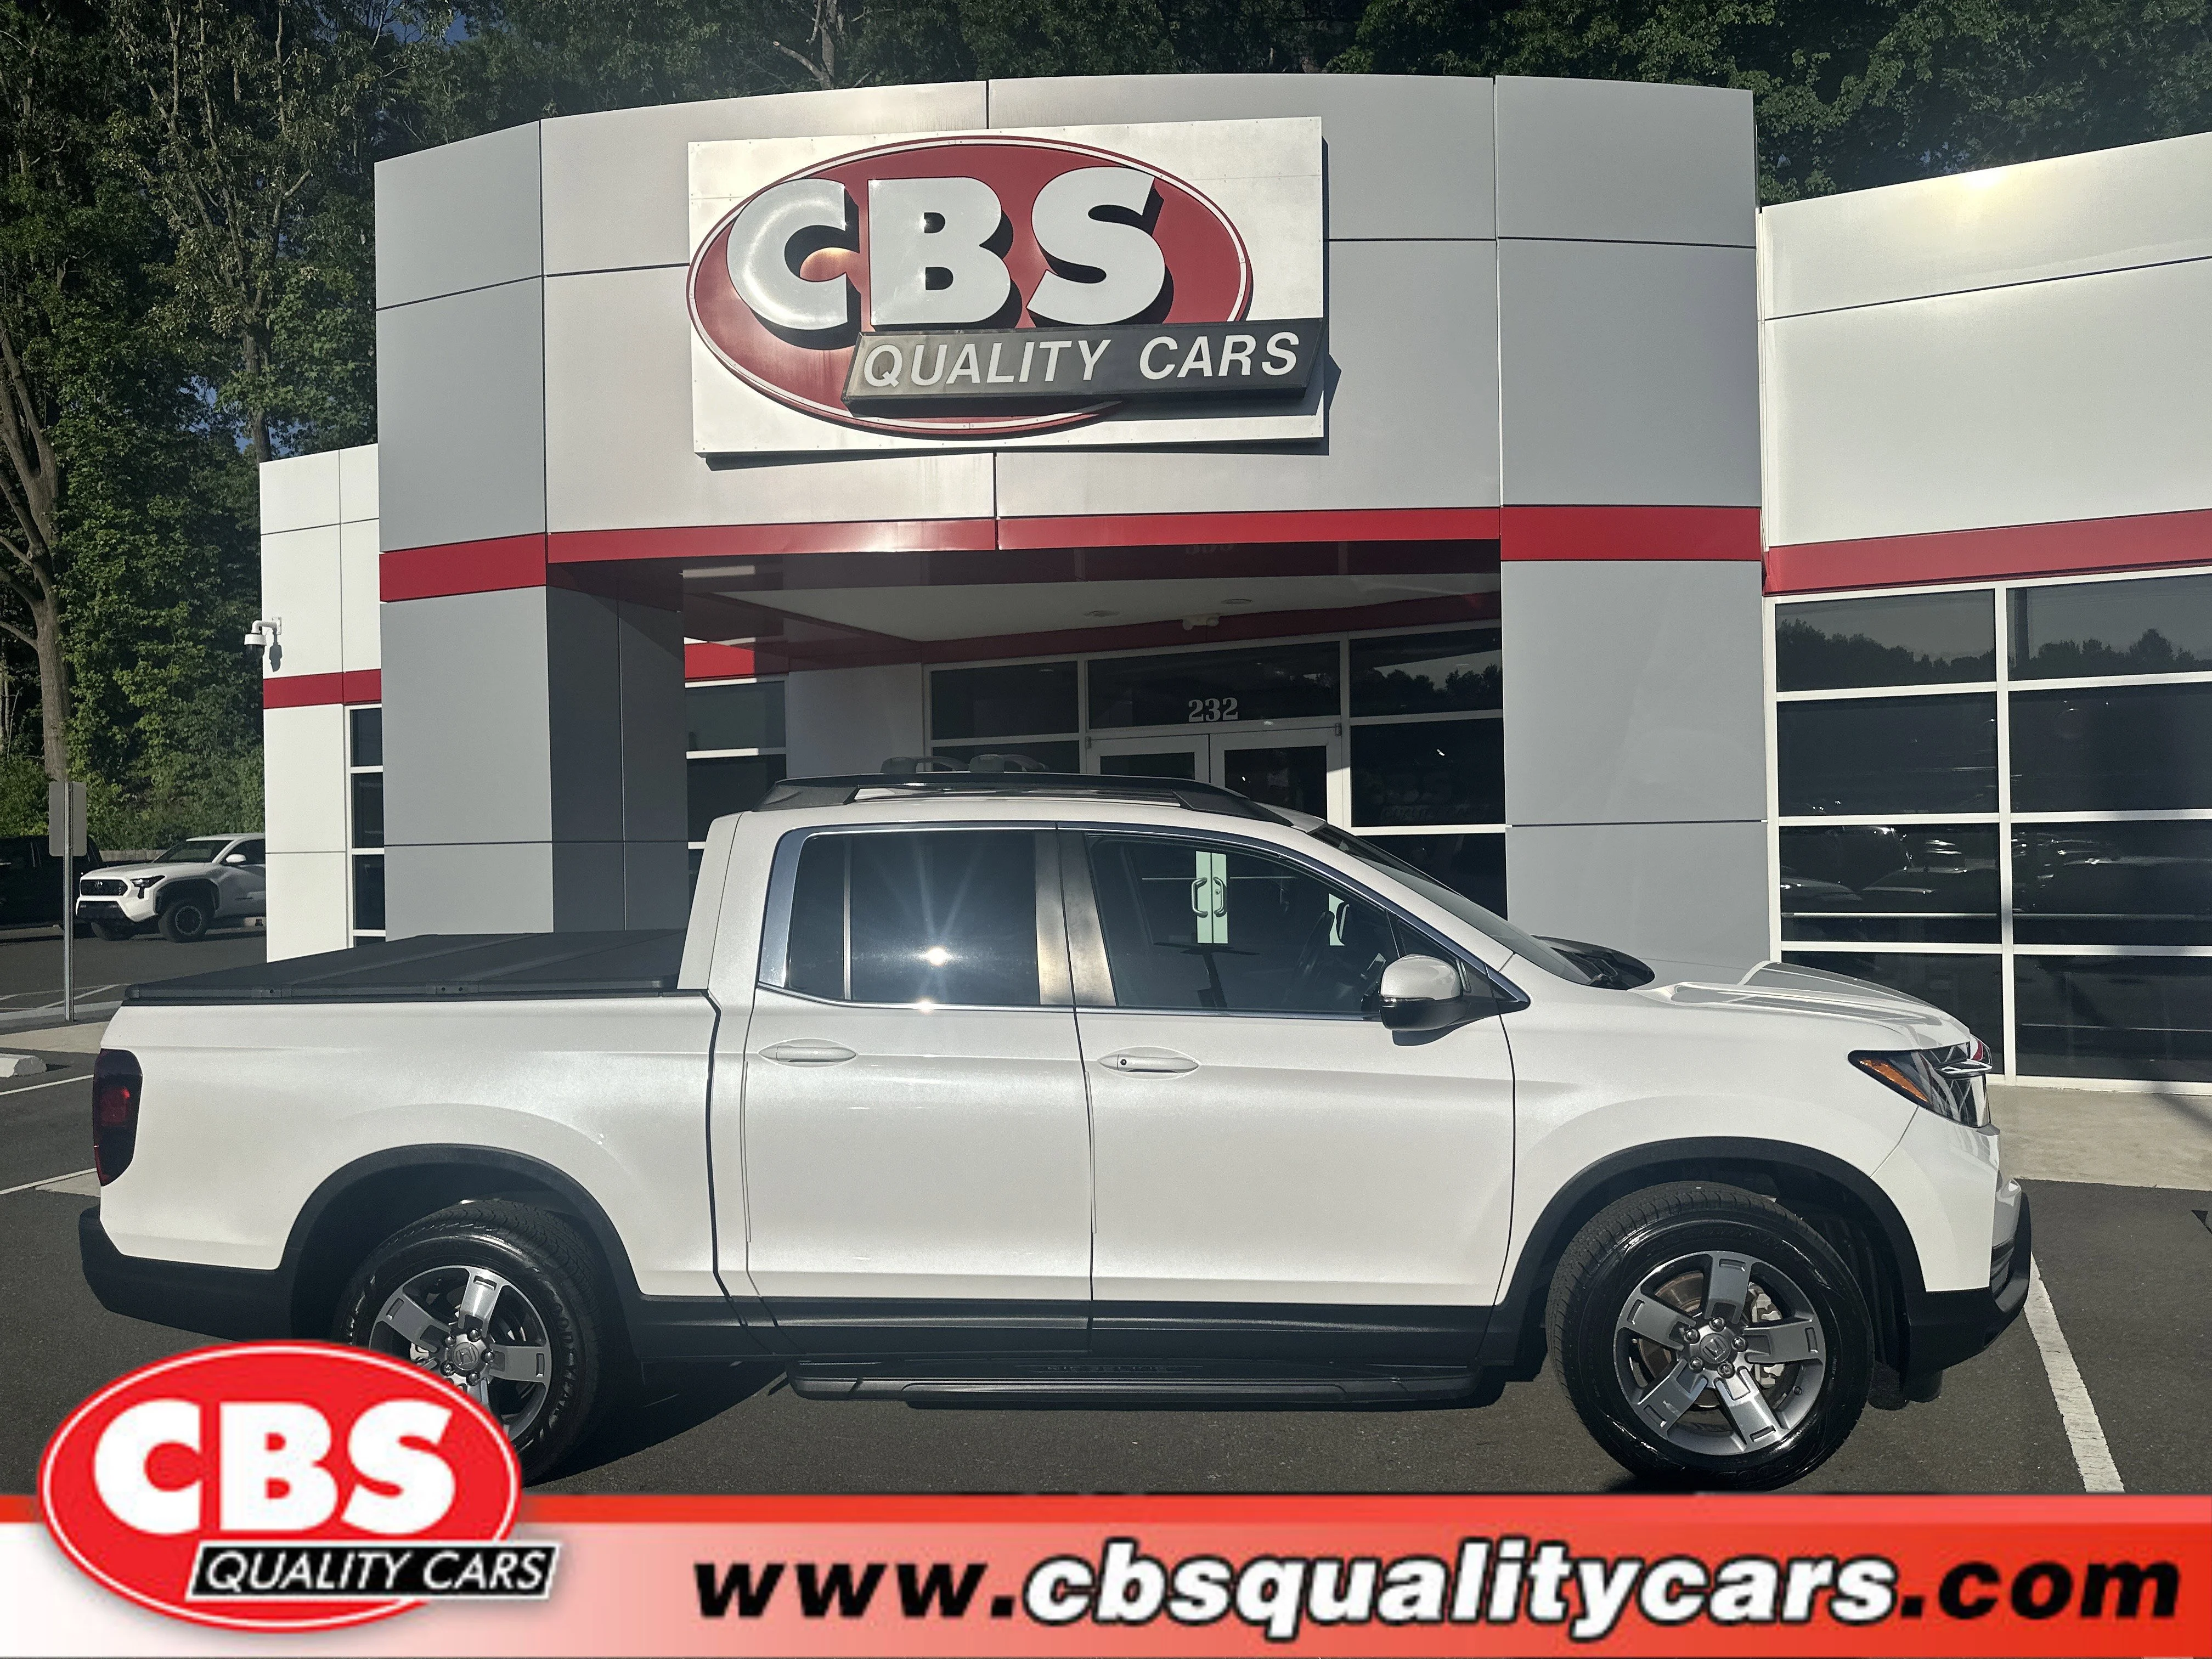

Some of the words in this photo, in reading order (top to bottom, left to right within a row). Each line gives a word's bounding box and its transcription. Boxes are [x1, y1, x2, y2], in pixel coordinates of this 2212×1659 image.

[726, 166, 1166, 330] CBS
[863, 338, 1111, 388] QUALITY
[1139, 330, 1300, 380] CARS
[1187, 697, 1239, 723] 232
